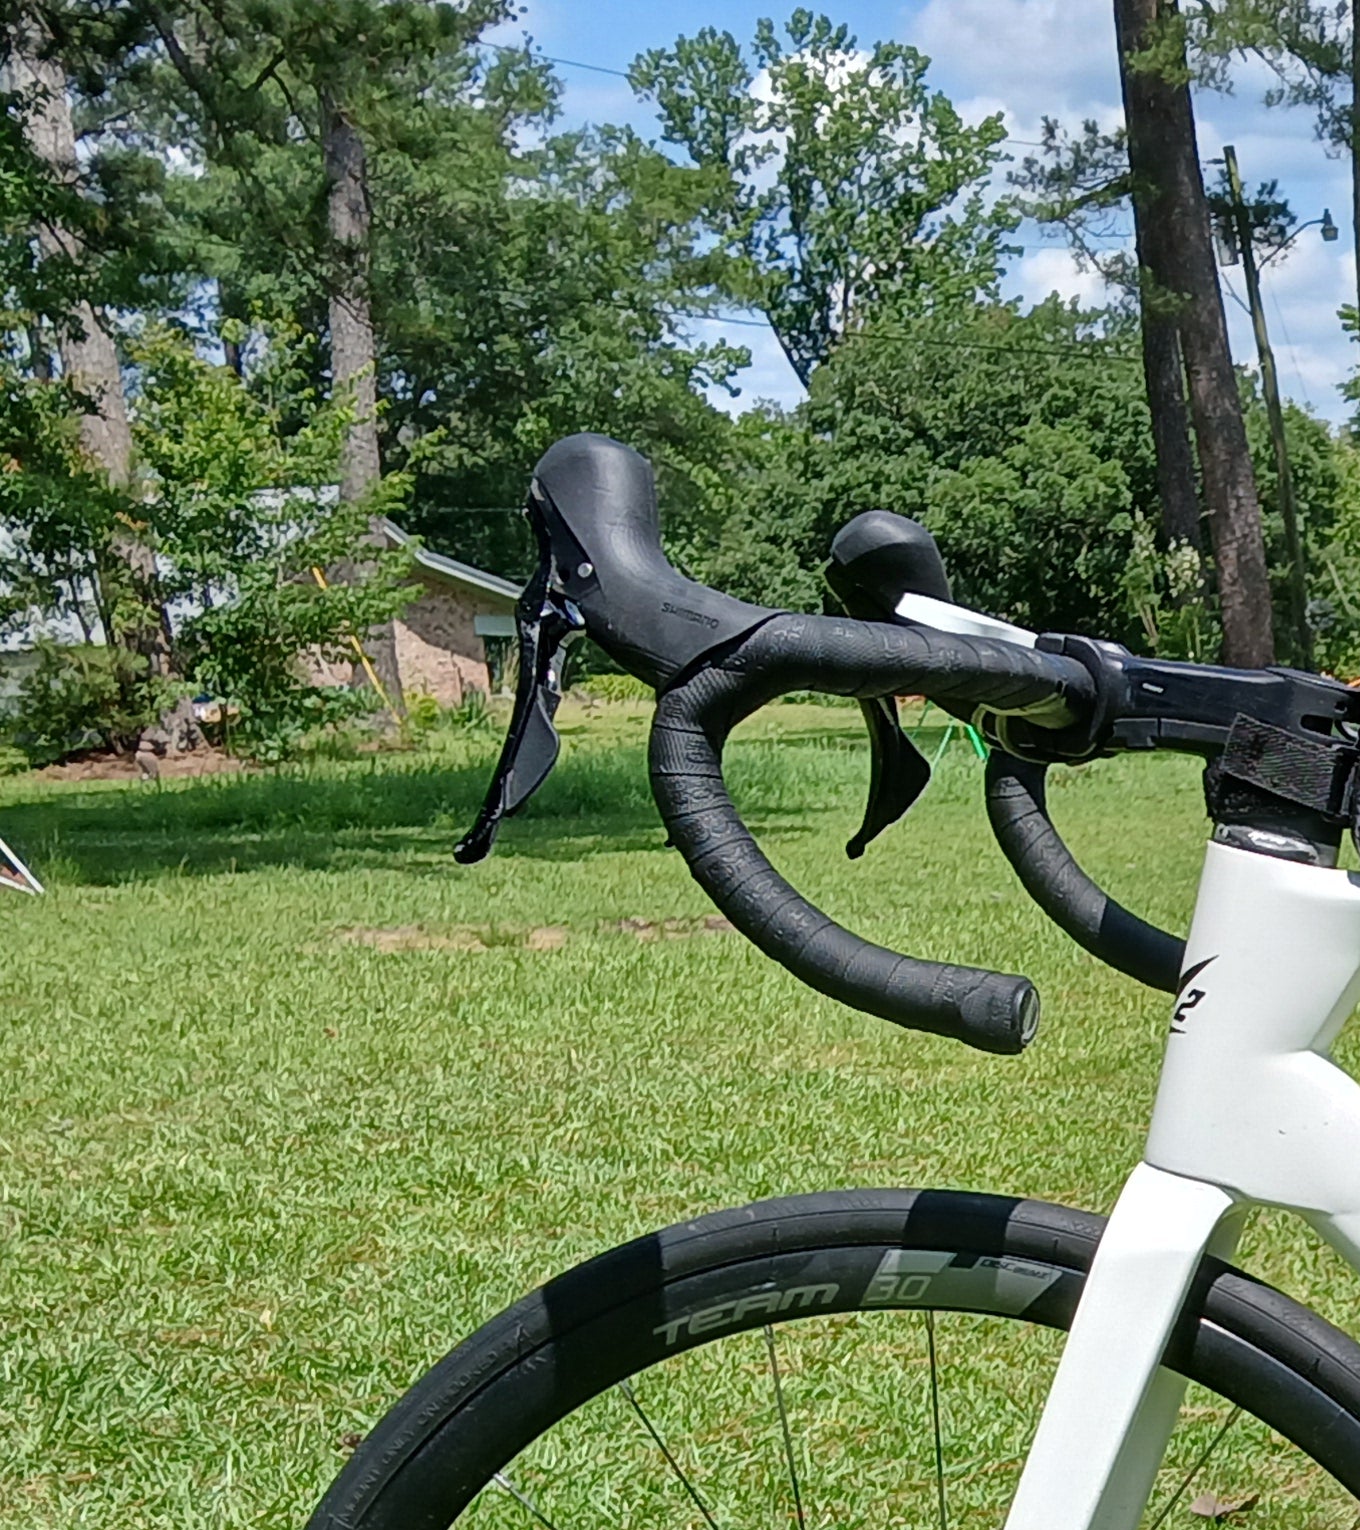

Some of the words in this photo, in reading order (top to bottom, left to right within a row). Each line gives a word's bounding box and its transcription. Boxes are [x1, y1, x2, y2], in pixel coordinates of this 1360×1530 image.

[661, 602, 719, 629] SHIMANO
[652, 1282, 840, 1346] TEAM
[864, 1274, 932, 1301] 30
